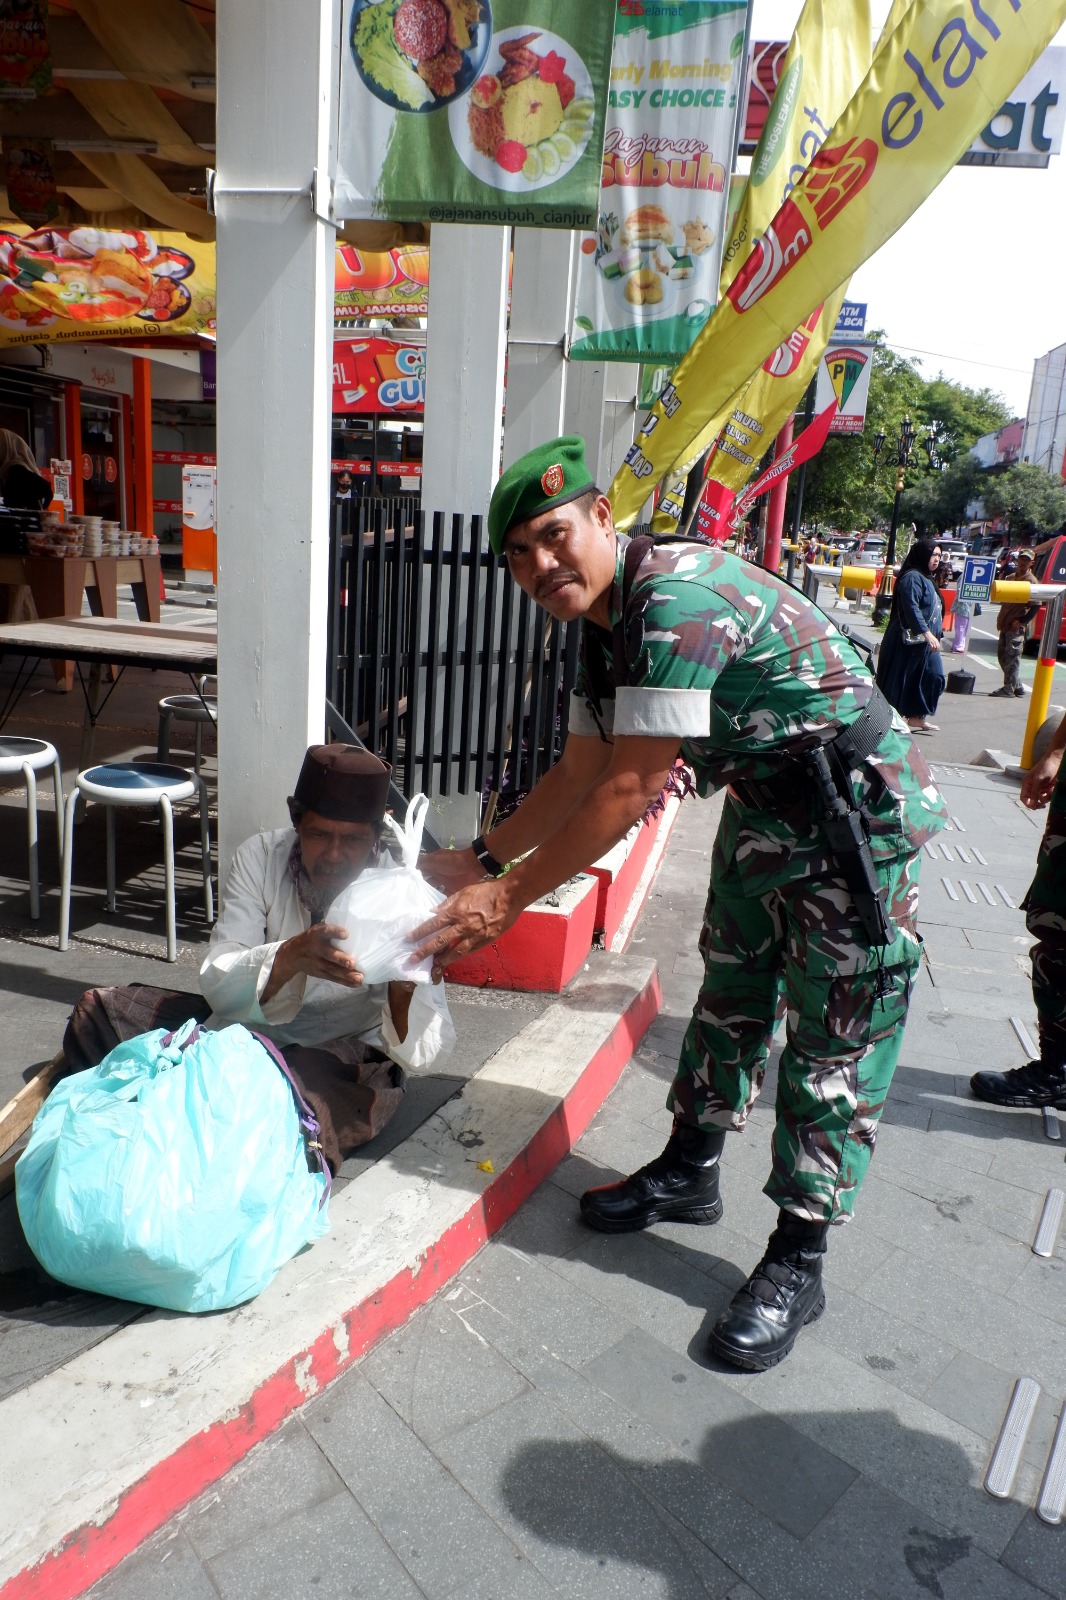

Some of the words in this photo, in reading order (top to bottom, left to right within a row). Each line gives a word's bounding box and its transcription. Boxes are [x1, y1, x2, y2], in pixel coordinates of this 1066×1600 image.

[648, 58, 733, 82] Morning
[649, 88, 726, 108] CHOICE
[755, 153, 771, 177] THE
[768, 103, 790, 153] MOSLEM
[429, 207, 592, 228] @jajanansubuh_cianjur
[838, 306, 860, 317] ATM
[843, 316, 863, 327] BCA
[971, 566, 985, 582] P
[965, 585, 987, 593] PARKIR
